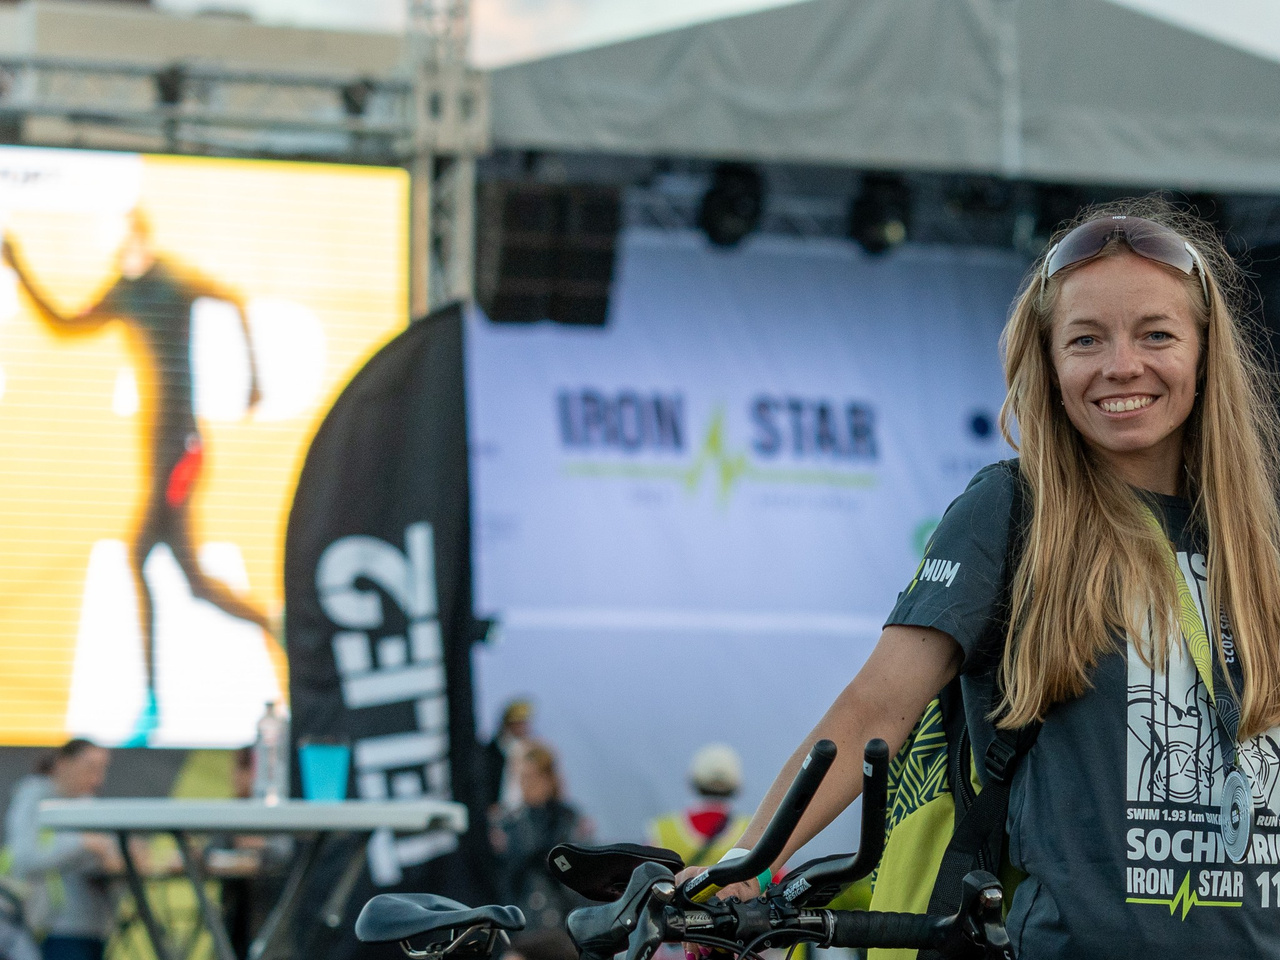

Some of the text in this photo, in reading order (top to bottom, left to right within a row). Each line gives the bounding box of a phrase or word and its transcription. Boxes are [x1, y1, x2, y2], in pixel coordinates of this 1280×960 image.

[557, 388, 880, 460] IRON STAR
[919, 558, 961, 588] MUM
[1221, 633, 1235, 664] 2023
[1126, 807, 1159, 821] SWIM
[1162, 809, 1186, 822] 1.93
[1188, 811, 1205, 823] km
[1256, 815, 1278, 827] RUN
[1126, 827, 1225, 864] SOCHI
[1126, 867, 1174, 895] IRON
[1198, 869, 1244, 898] STAR
